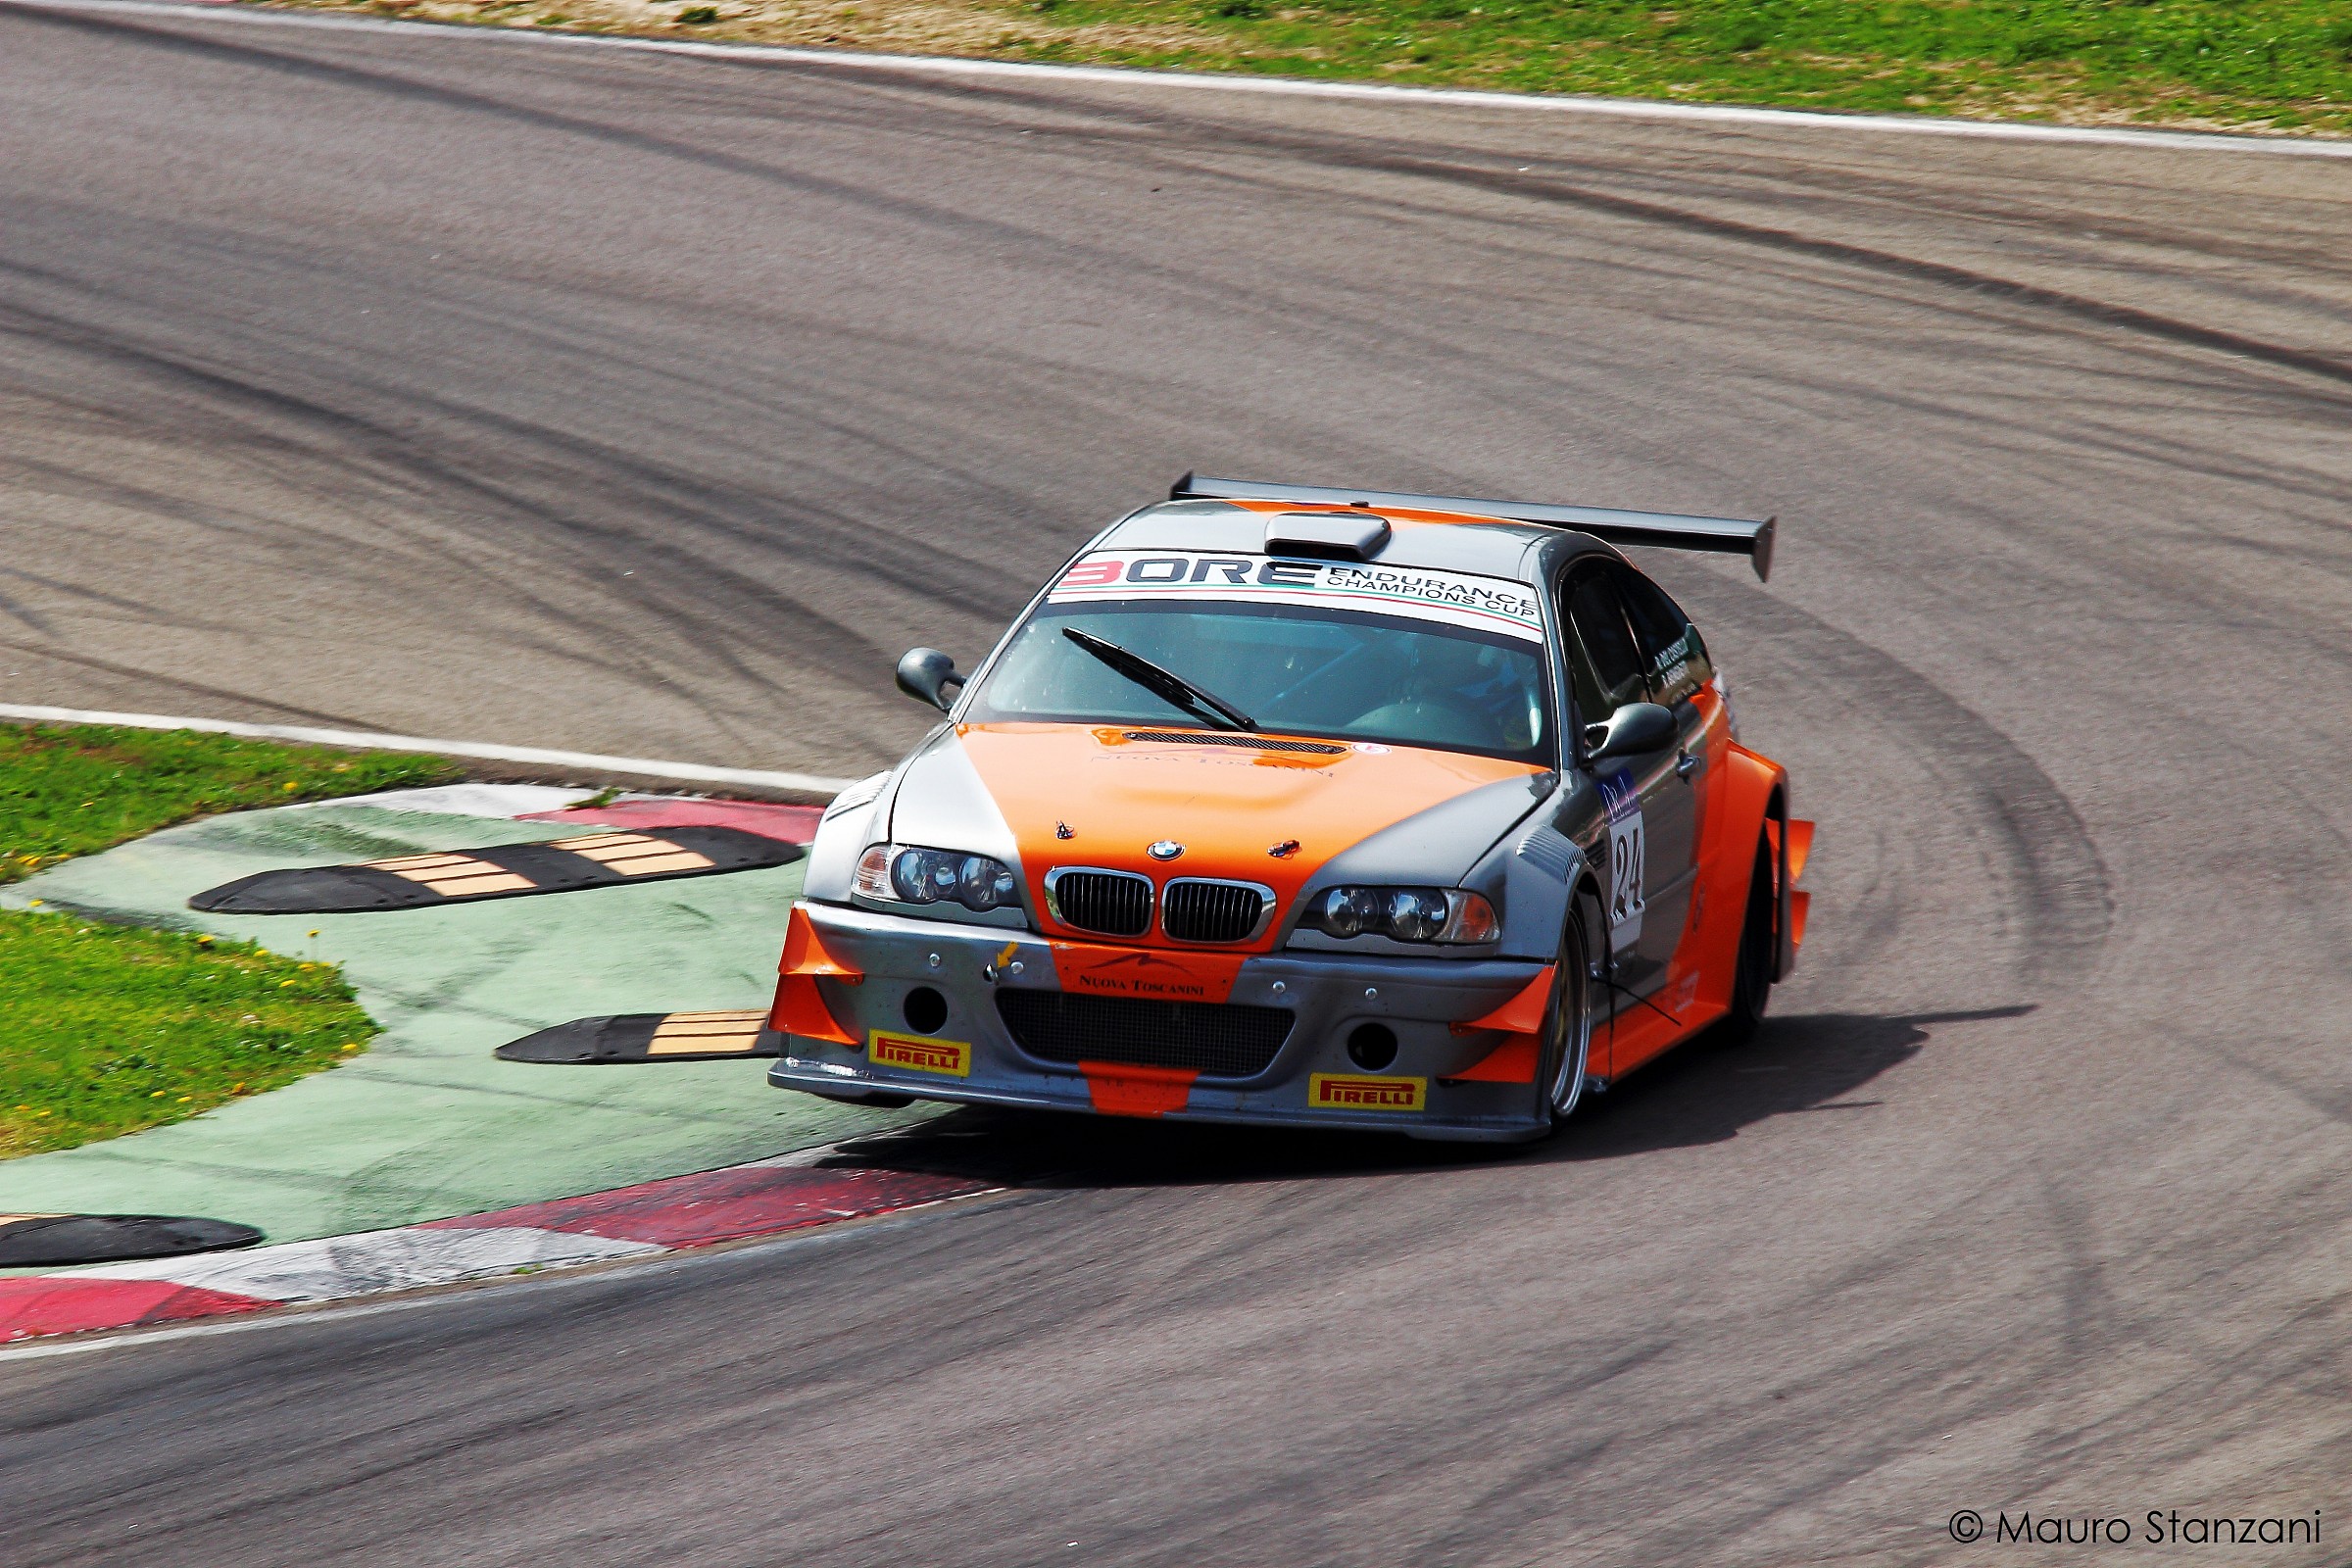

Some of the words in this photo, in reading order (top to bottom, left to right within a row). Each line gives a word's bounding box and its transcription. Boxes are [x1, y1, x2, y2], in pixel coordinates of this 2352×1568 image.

[1327, 576, 1476, 605] CHAMPIONS
[1485, 600, 1535, 616] CUP
[1330, 566, 1538, 610] ENDURANCE
[1613, 827, 1642, 919] 24
[876, 1036, 960, 1070] PIRELLI
[1319, 1079, 1415, 1105] PIRELLI
